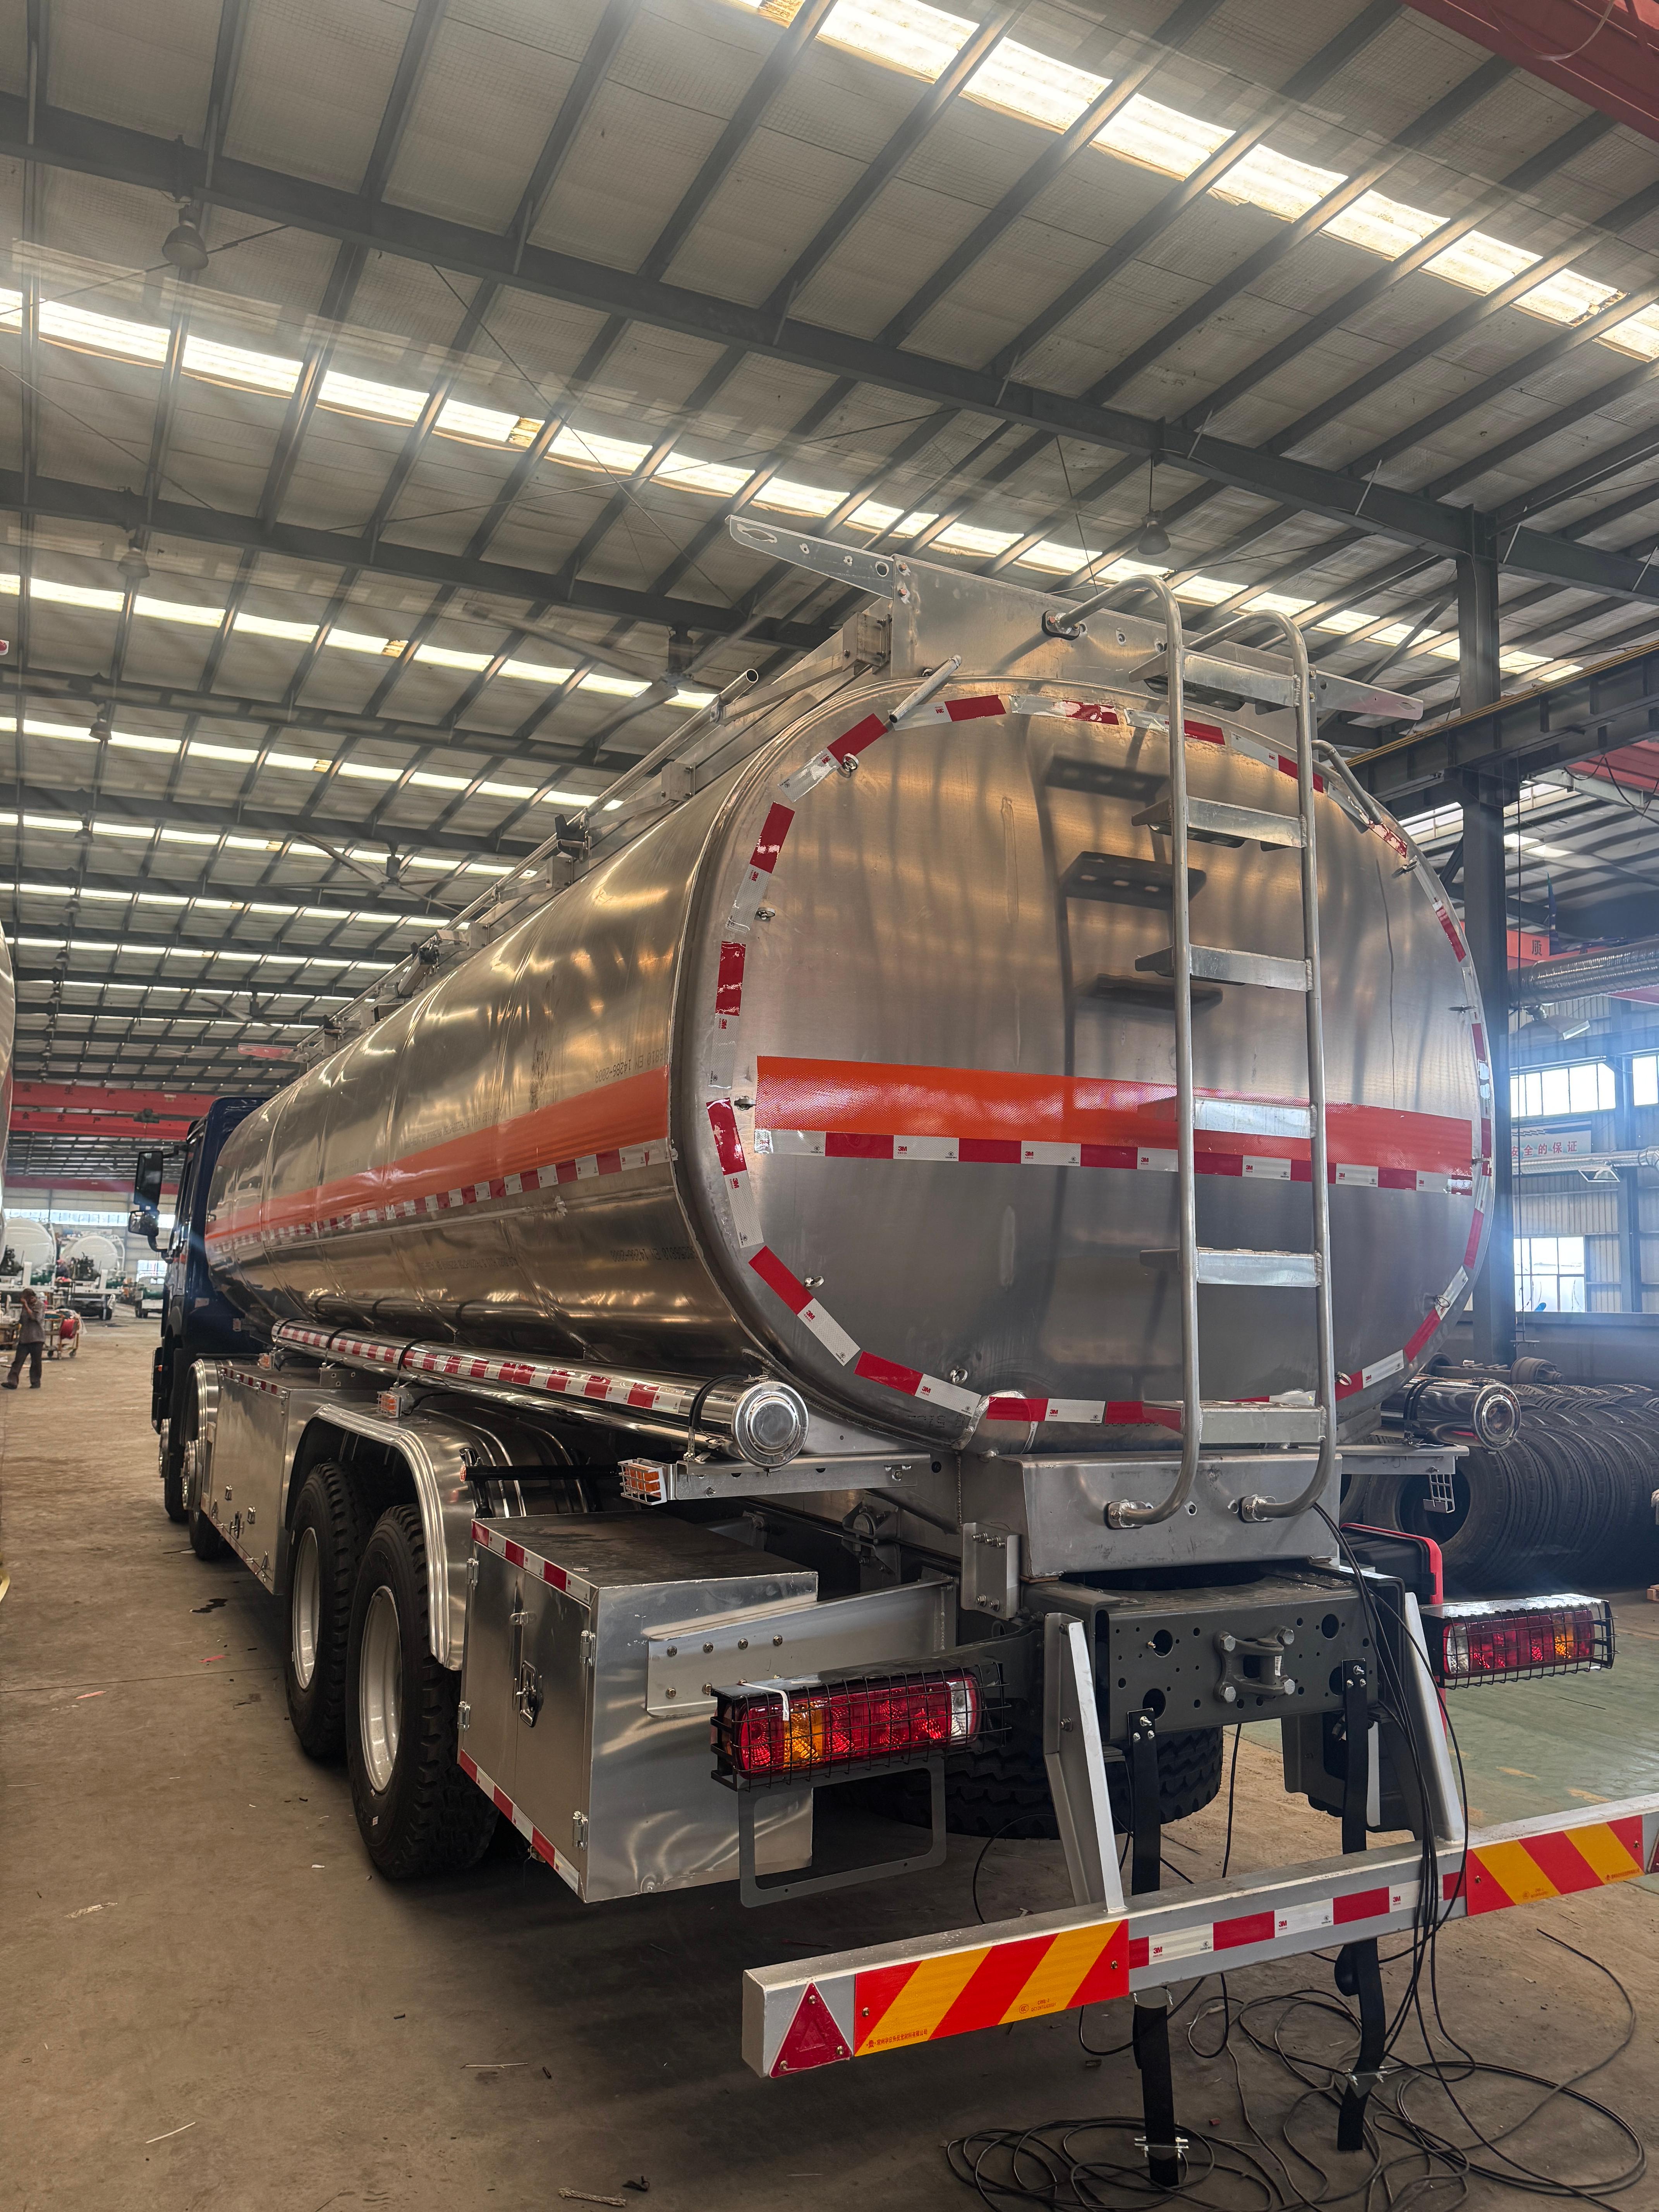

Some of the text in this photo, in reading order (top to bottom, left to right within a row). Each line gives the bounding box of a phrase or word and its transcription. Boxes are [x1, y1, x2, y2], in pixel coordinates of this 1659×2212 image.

[822, 756, 831, 764] 3M
[751, 871, 759, 881] 3M
[721, 1019, 727, 1029] 3M
[635, 1054, 644, 1070] EN
[1511, 1141, 1577, 1157] 安全的保证
[733, 1178, 739, 1188] 3M
[806, 1310, 815, 1320] 3M
